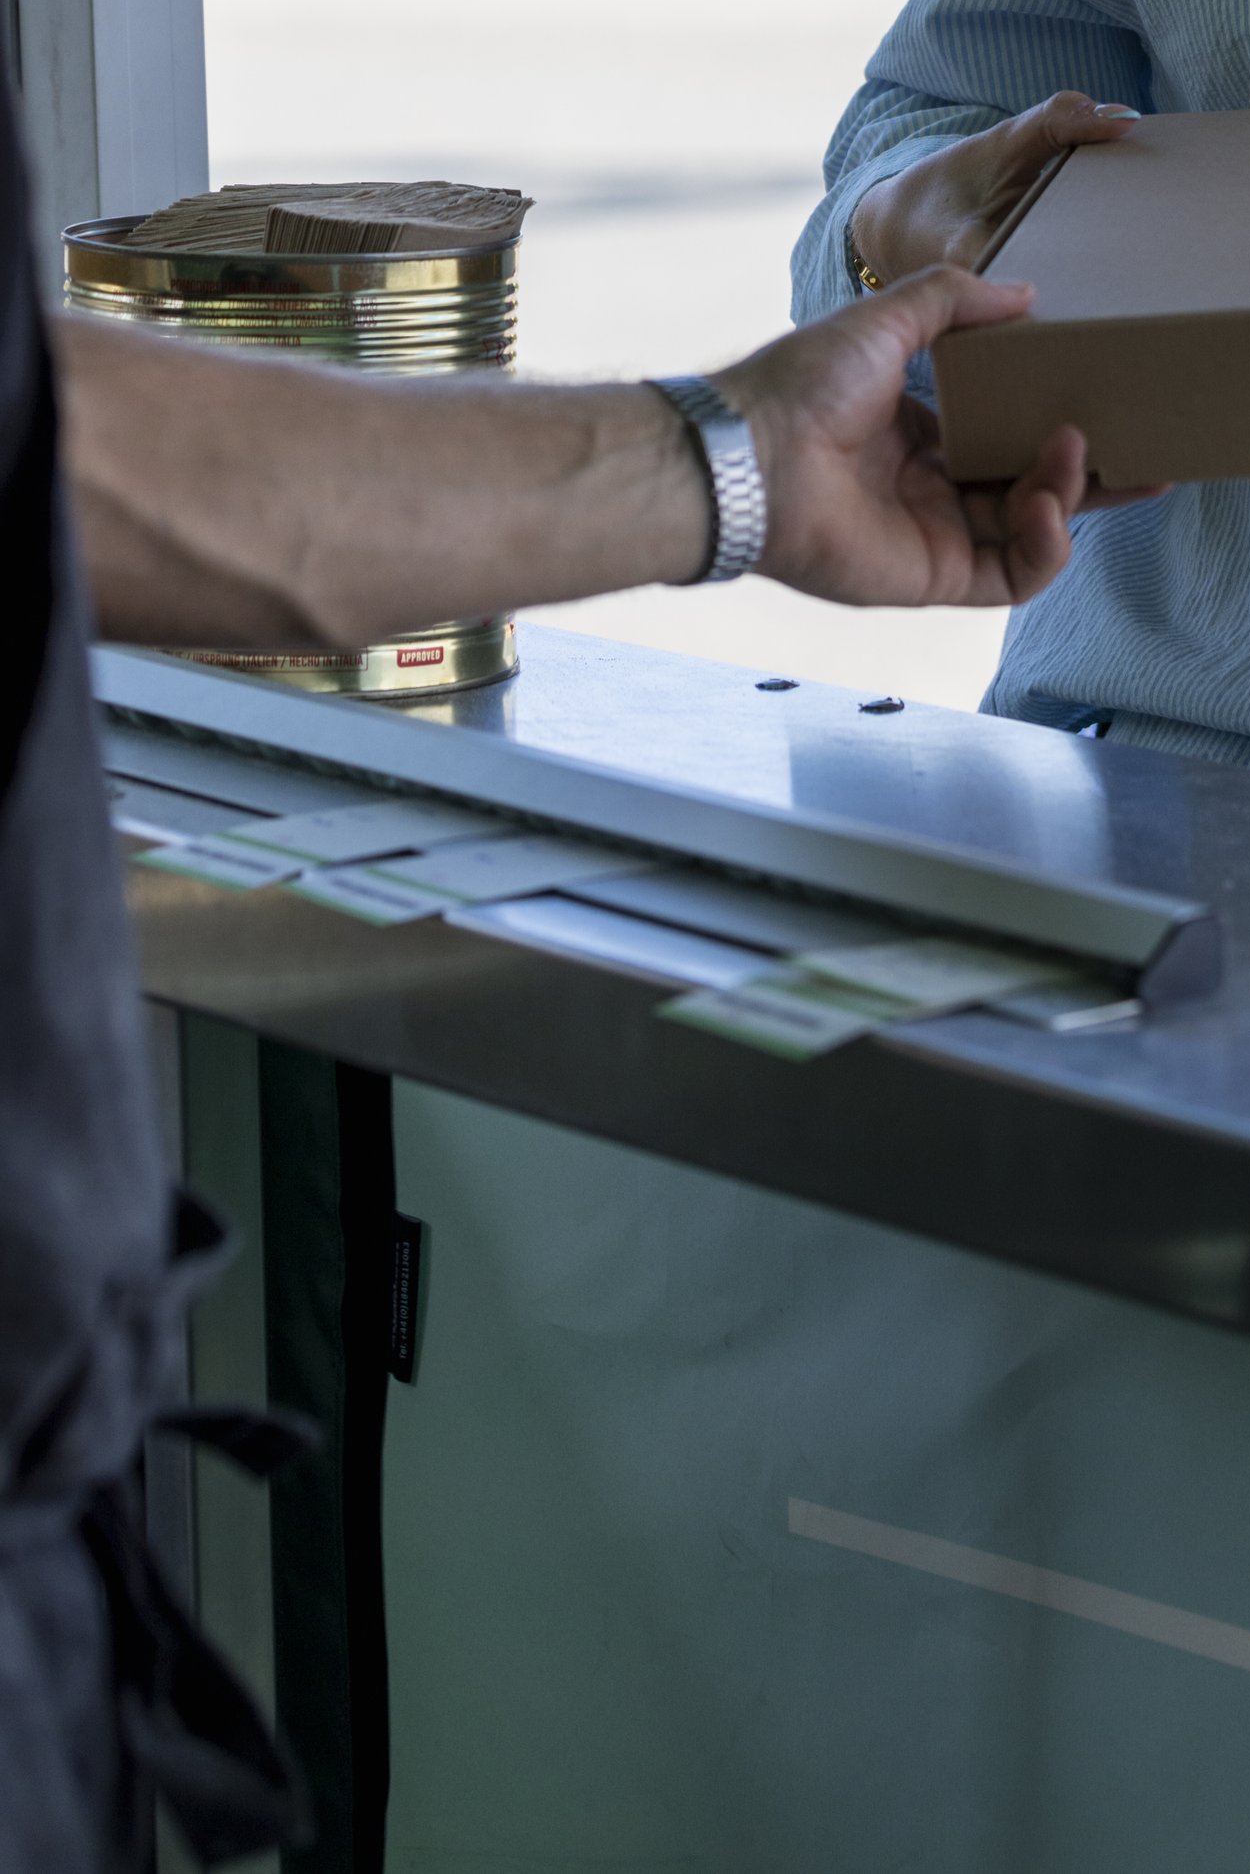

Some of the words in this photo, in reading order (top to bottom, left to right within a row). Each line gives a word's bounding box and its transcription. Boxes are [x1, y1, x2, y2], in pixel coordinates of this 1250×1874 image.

[289, 653, 319, 667] HECHO
[322, 653, 332, 667] IN
[335, 653, 363, 667] ITALIA
[400, 649, 441, 664] APPROVED
